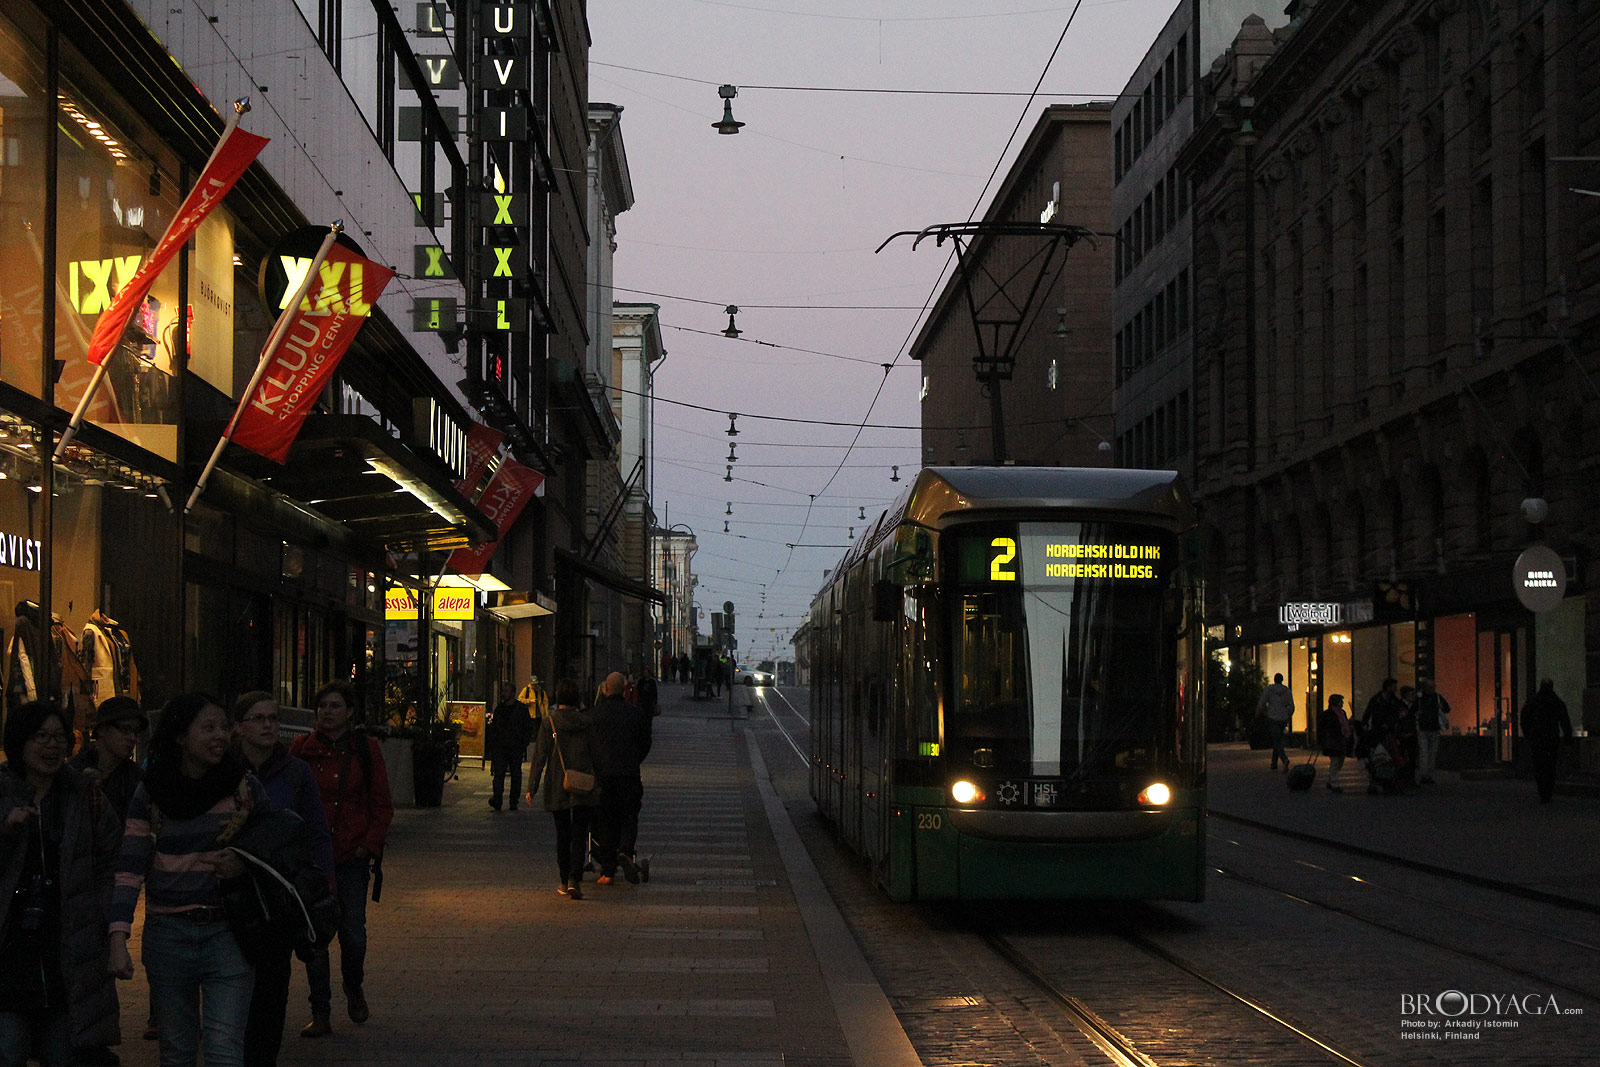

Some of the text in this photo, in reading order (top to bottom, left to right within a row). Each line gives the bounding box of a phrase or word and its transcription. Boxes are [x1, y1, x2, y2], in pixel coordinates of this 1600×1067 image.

[493, 195, 513, 329] XXL
[279, 256, 371, 317] XXL
[279, 296, 353, 421] SHOPPING CENTER
[430, 397, 466, 480] KLUUVI
[990, 537, 1016, 581] 2
[1046, 563, 1158, 579] NORDENSKIÖLDSG.
[438, 596, 471, 611] alepa
[1289, 608, 1329, 619] Wolford
[1034, 783, 1058, 794] HSL
[1034, 794, 1058, 804] HRT
[918, 813, 942, 829] 230
